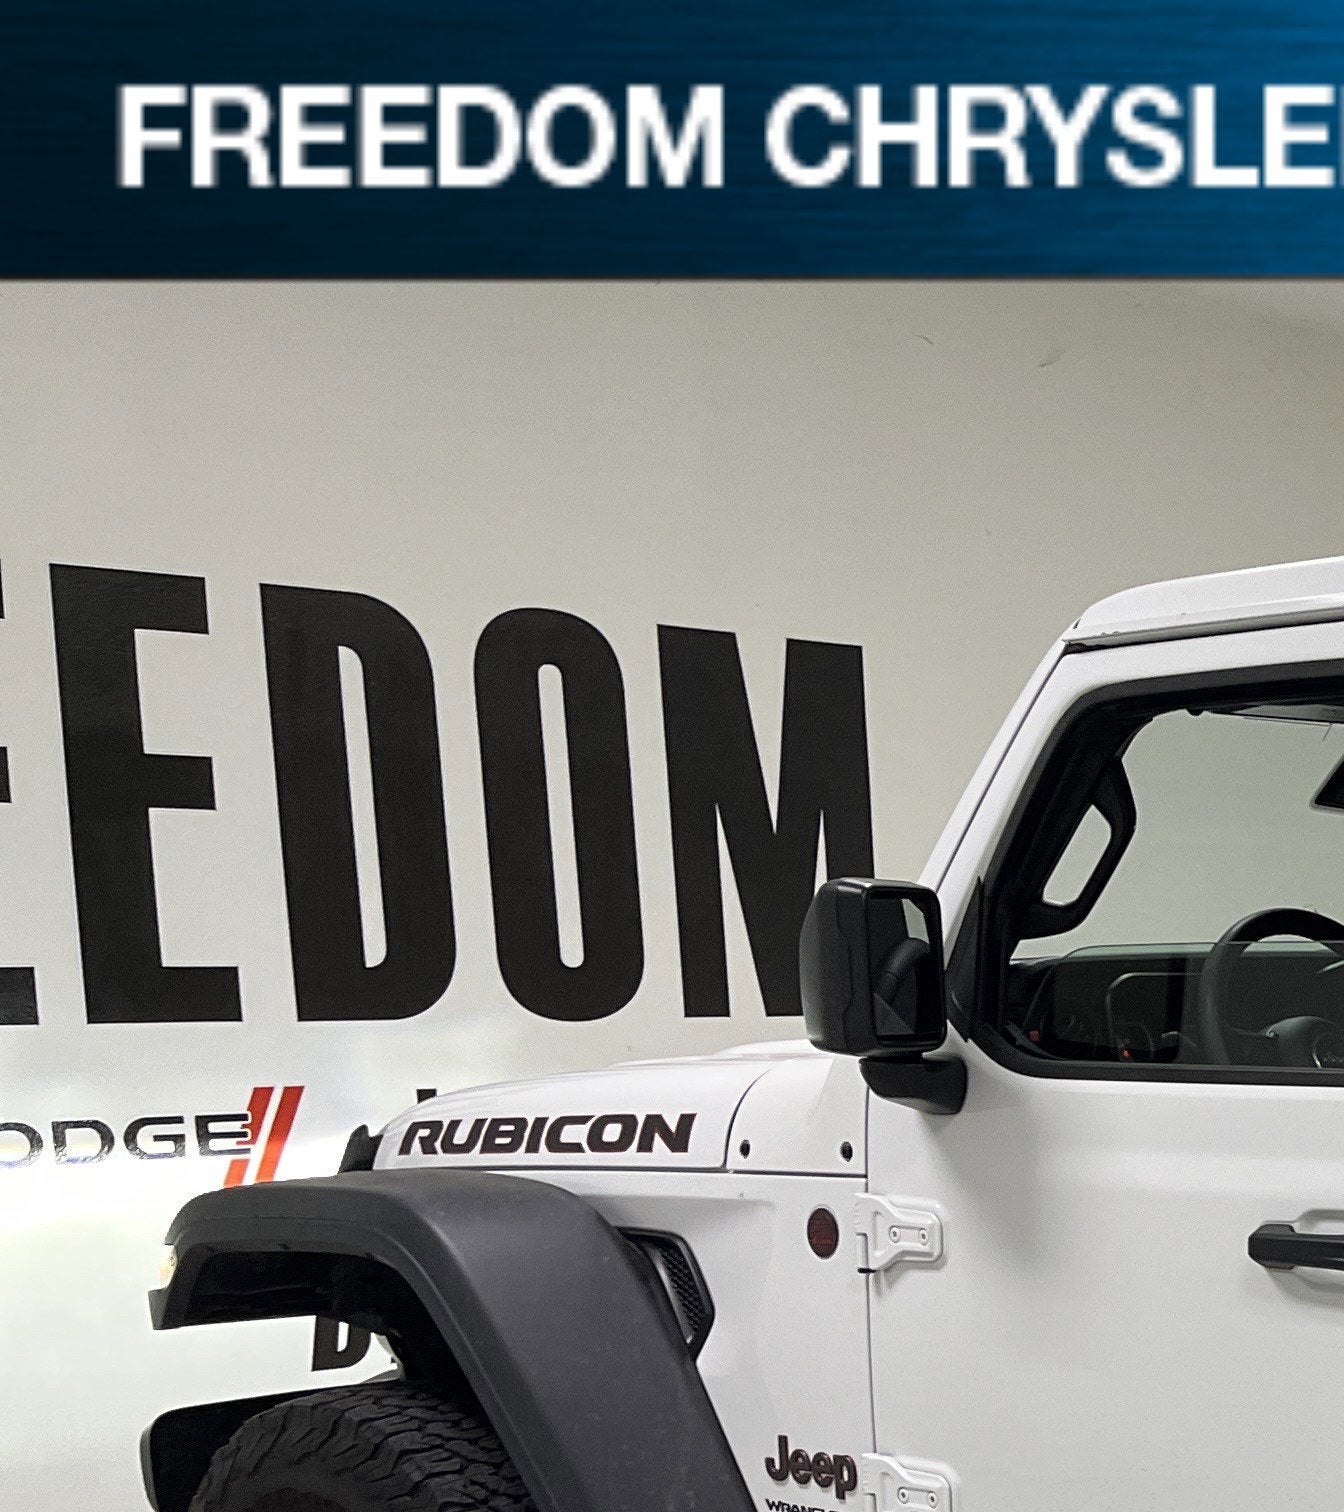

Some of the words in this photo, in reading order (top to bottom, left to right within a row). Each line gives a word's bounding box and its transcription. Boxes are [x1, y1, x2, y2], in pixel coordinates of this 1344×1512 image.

[0, 558, 877, 1025] EDOM
[398, 1112, 698, 1157] RUBICON
[764, 1434, 858, 1500] Jeep
